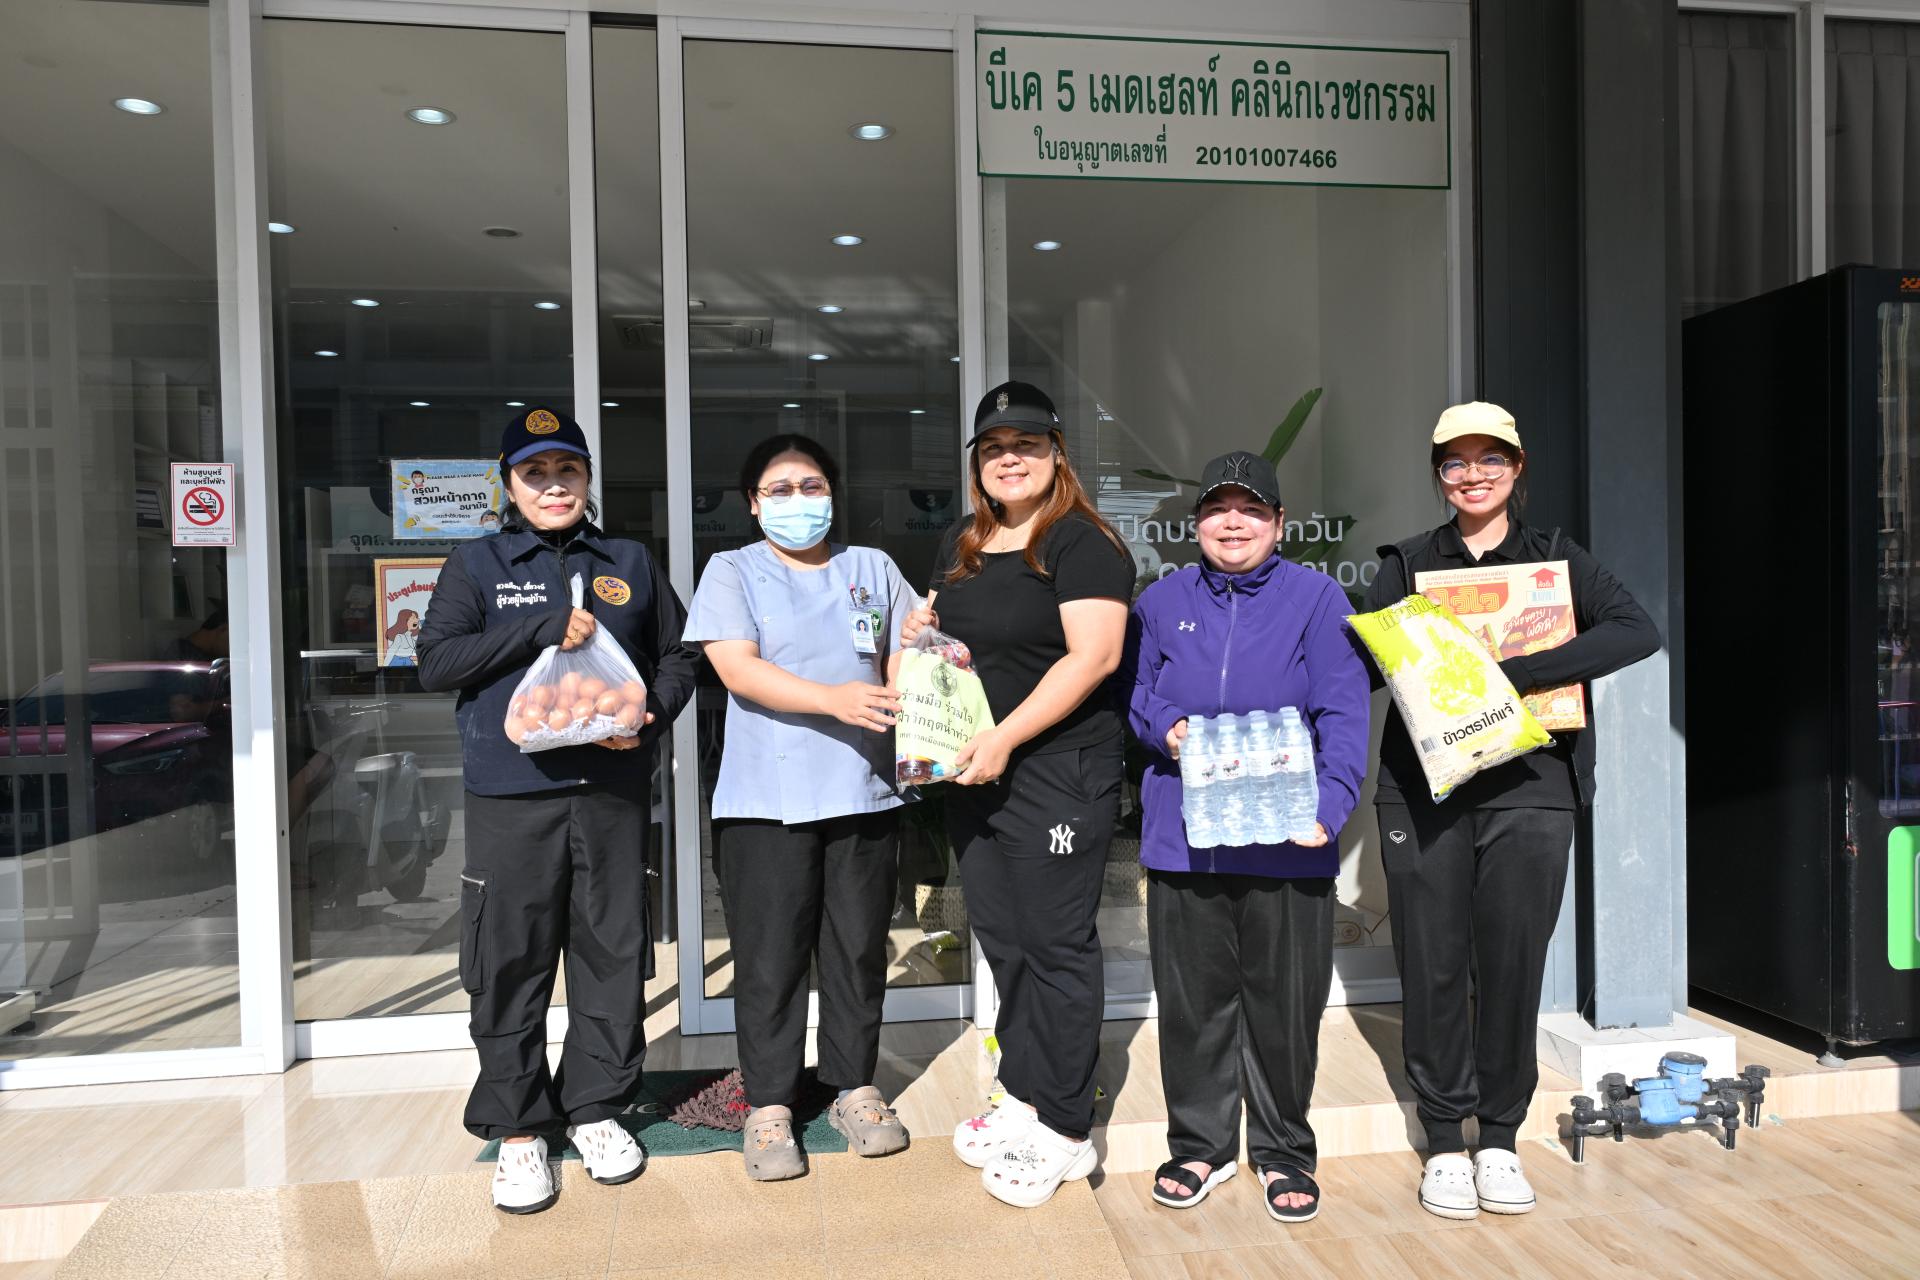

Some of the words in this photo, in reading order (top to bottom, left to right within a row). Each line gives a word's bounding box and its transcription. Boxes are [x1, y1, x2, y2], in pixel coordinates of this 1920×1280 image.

[986, 47, 1042, 112] บีเค
[1057, 69, 1075, 112] 5
[1089, 54, 1220, 115] เมดเฮลท์
[1232, 60, 1436, 123] คลินิกเวชกรรม
[1034, 125, 1168, 172] ใบอนุญาตเลขที่
[1196, 146, 1338, 169] 20101007466
[183, 467, 222, 477] ห้ามสูบบุหรี่
[1224, 455, 1252, 479] NY
[180, 477, 225, 486] และบุหรี่ไฟฟ้า
[411, 486, 440, 496] กรุณา
[414, 491, 487, 505] สวมหน้ากาก
[459, 502, 488, 511] อนามัย
[1443, 702, 1514, 746] ข้าวตราไก่แจ้
[1048, 823, 1076, 855] NY
